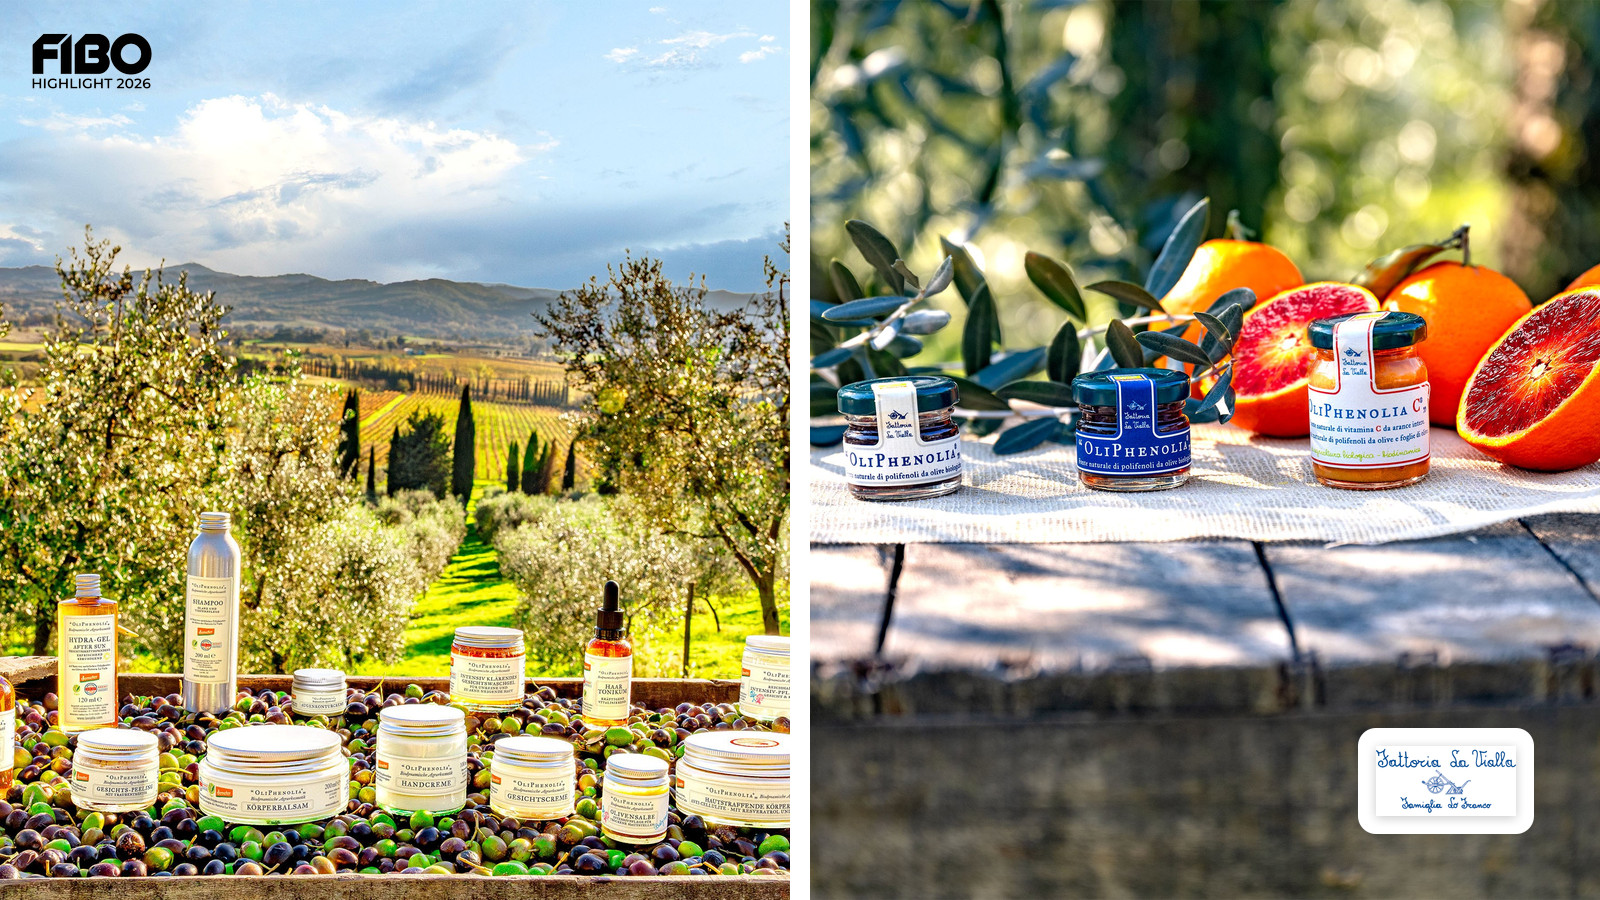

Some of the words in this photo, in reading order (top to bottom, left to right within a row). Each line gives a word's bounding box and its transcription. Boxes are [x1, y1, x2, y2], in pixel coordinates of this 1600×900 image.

[1344, 425, 1374, 433] vitamina
[1392, 423, 1411, 431] arance
[1335, 437, 1366, 445] polifenoli
[1377, 436, 1393, 444] olive
[1400, 433, 1415, 442] foglie
[1342, 449, 1374, 462] biologica
[1121, 461, 1154, 471] polifenoli
[1165, 459, 1177, 467] olive
[886, 471, 919, 481] polifenoli
[930, 468, 944, 476] olive
[401, 780, 452, 788] HANDCREME
[507, 793, 568, 802] GESICHTSCREME
[705, 797, 765, 809] HAUTSTRAFFENDE
[246, 802, 309, 811] KÖRPERBALSAM
[610, 809, 656, 820] OLIVENSALBE
